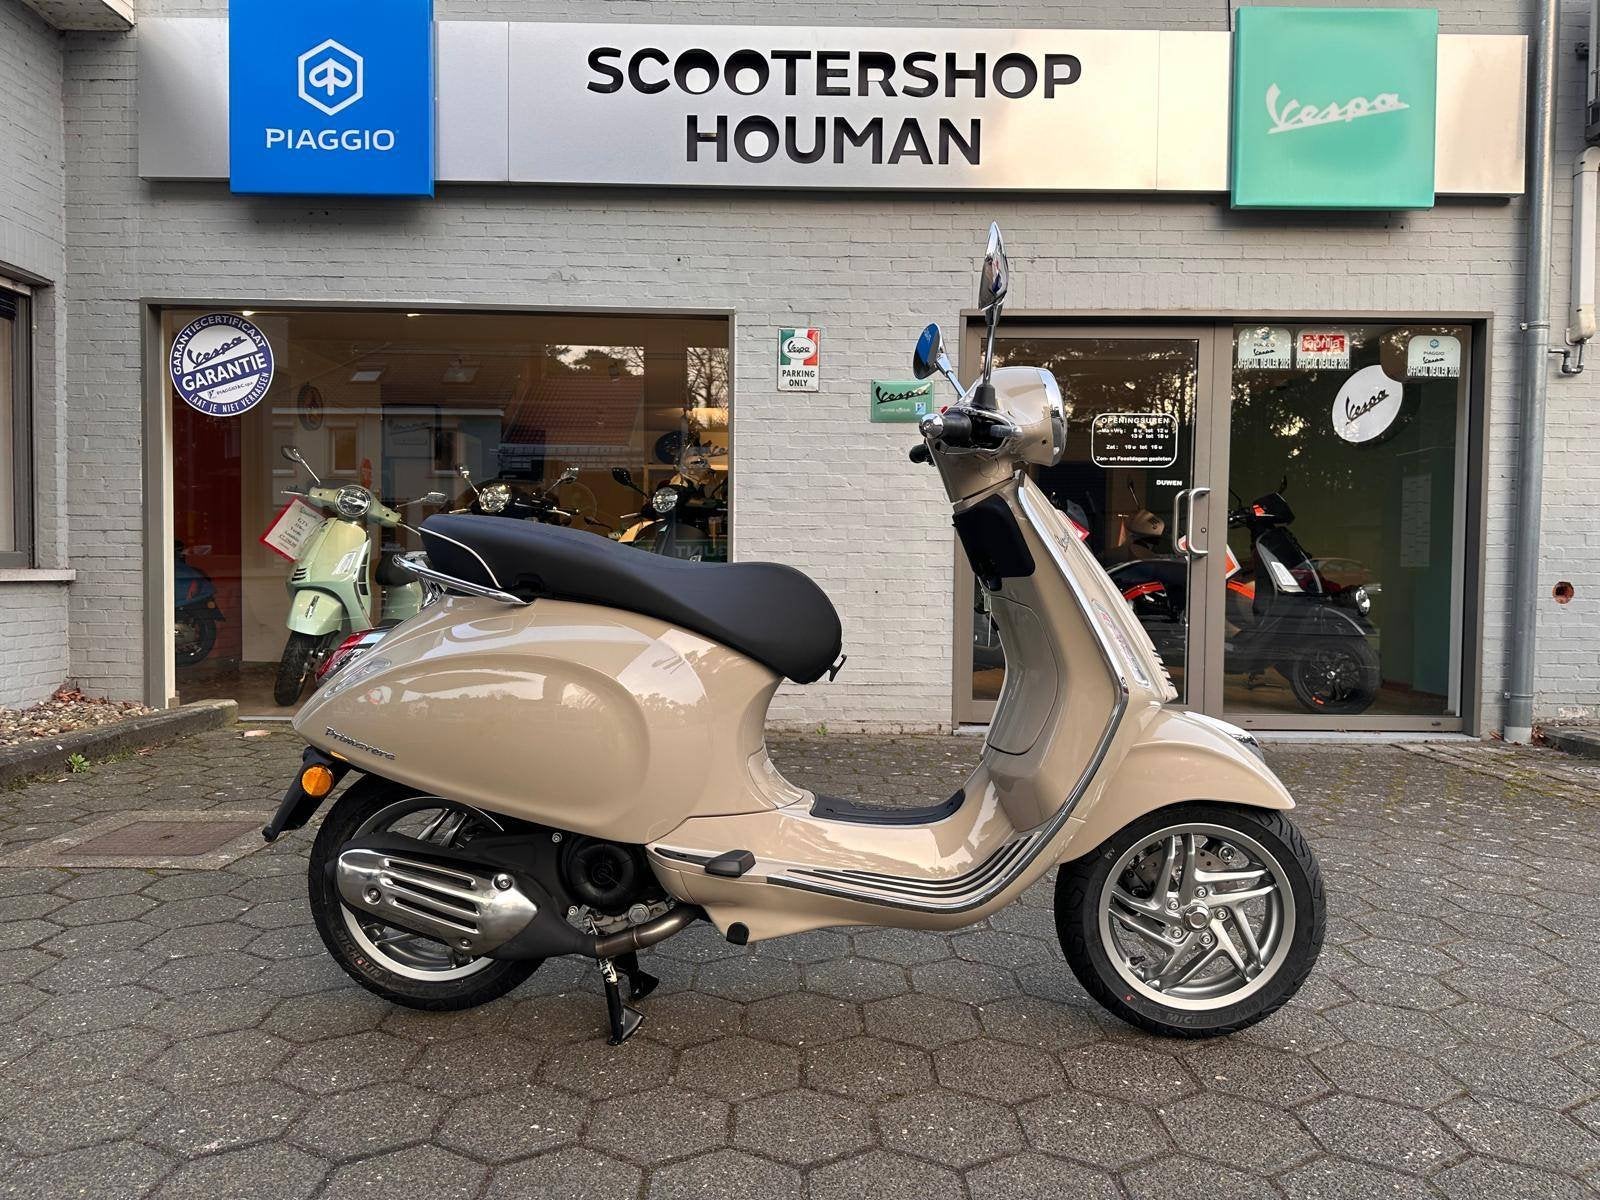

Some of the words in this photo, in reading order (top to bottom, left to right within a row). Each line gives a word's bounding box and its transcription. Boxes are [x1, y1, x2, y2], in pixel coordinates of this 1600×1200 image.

[587, 47, 1081, 99] SCOOTERSHOP
[1265, 82, 1410, 134] Vespa
[265, 128, 395, 151] PIAGGIO
[686, 115, 981, 165] HOUMAN
[173, 315, 266, 375] GARANTIECERTIFICAAT
[187, 336, 247, 369] Vespa
[787, 340, 811, 353] Vespa
[181, 352, 267, 391] GARANTIE
[782, 369, 815, 378] PARKING
[789, 379, 808, 387] ONLY
[188, 393, 206, 409] LAAT
[209, 404, 217, 413] JE
[222, 402, 240, 413] NIET
[242, 372, 270, 408] VERRASSEN
[875, 386, 929, 405] Vespa
[1344, 389, 1389, 426] Vespa
